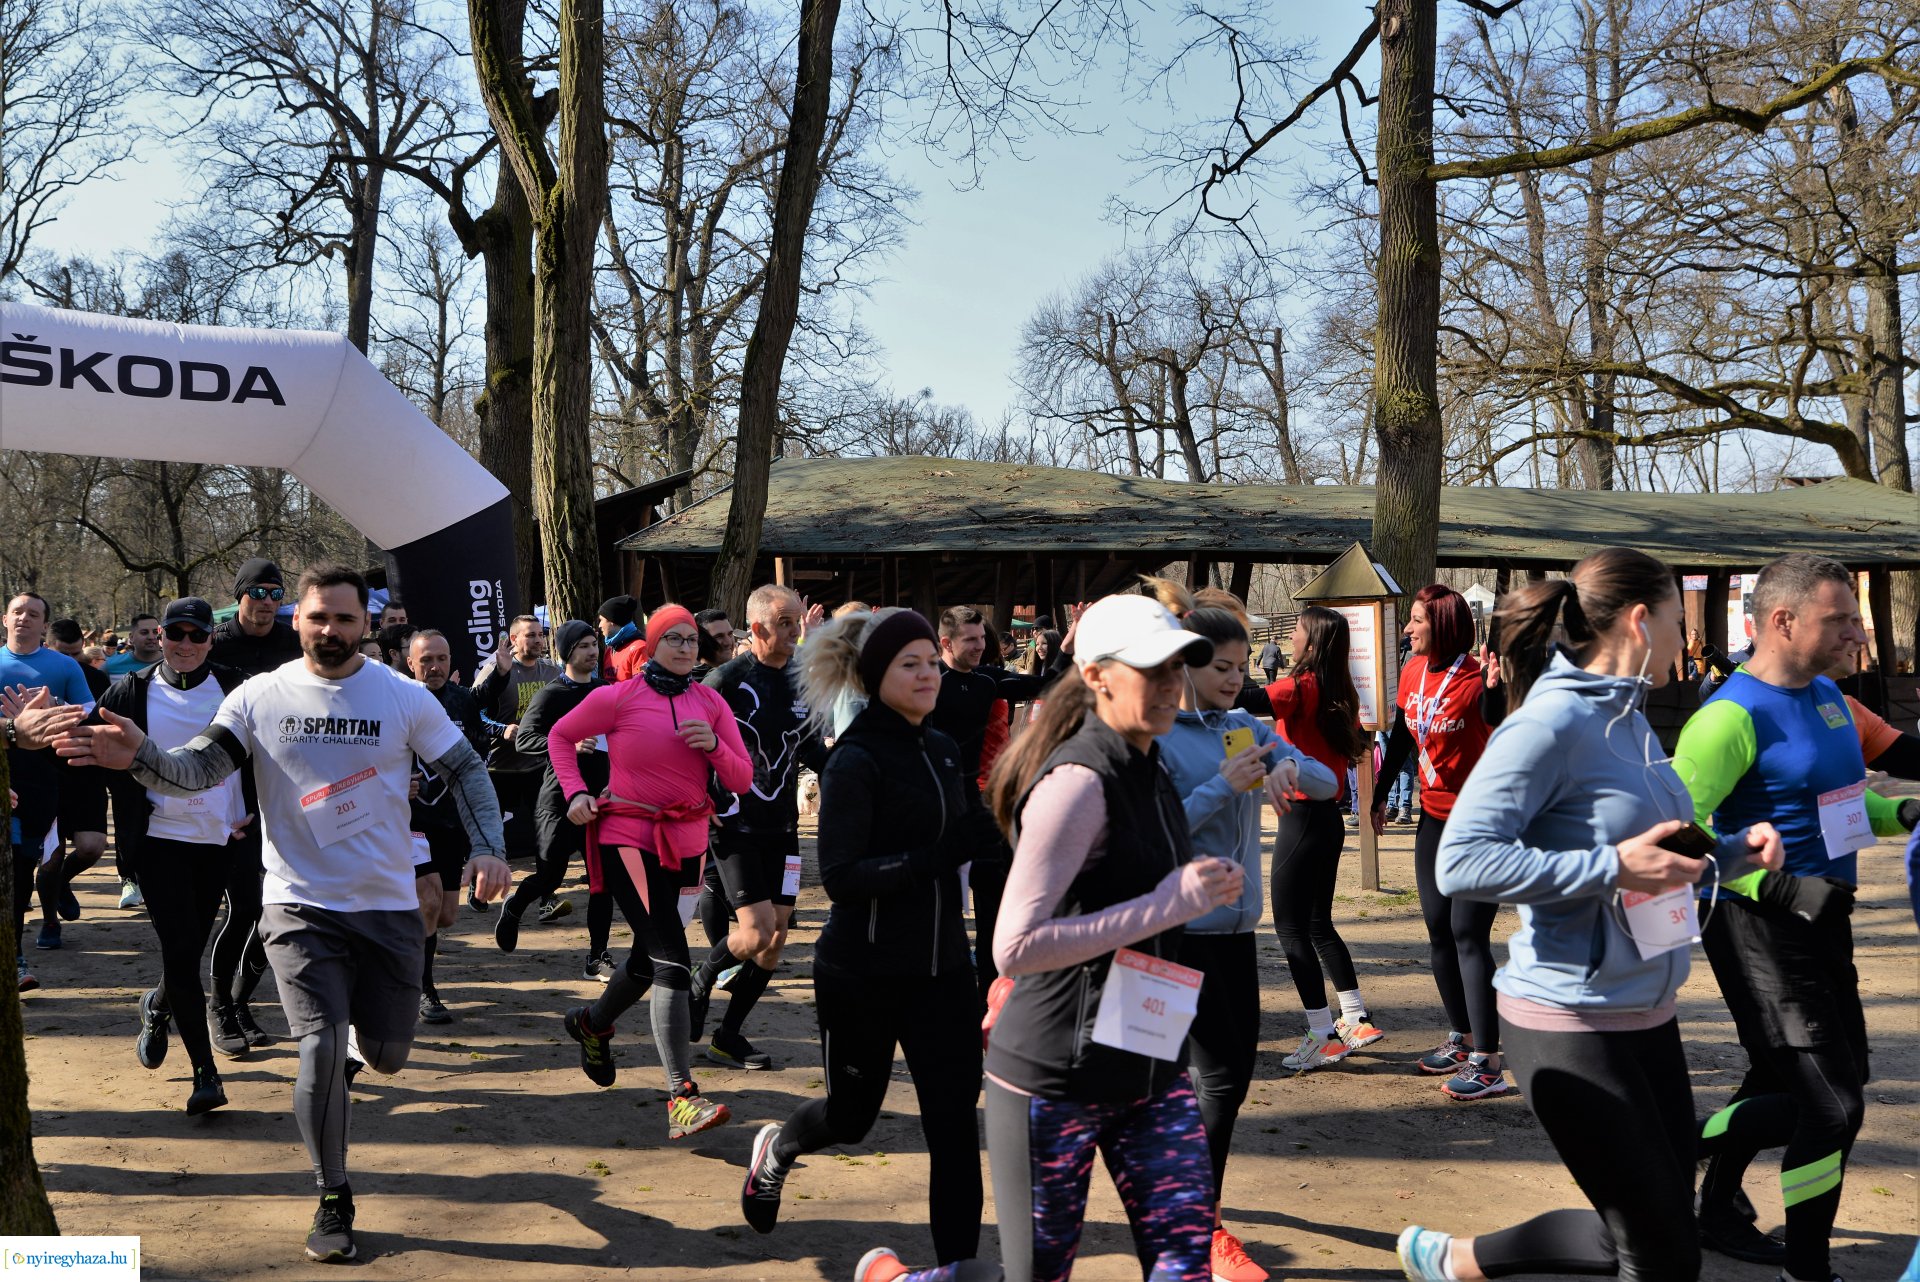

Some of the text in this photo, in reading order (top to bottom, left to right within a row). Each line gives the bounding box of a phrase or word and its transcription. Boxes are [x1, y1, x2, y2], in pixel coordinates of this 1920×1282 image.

[0, 333, 286, 406] ŠKODA
[495, 580, 506, 627] ŠKODA
[467, 580, 496, 680] ycling
[303, 717, 381, 737] SPARTAN
[279, 735, 380, 747] CHARITY CHALLENGE
[187, 798, 204, 806] 202
[305, 789, 326, 805] SPURI
[336, 800, 357, 816] 201
[1846, 811, 1863, 826] 307
[1142, 997, 1167, 1017] 401
